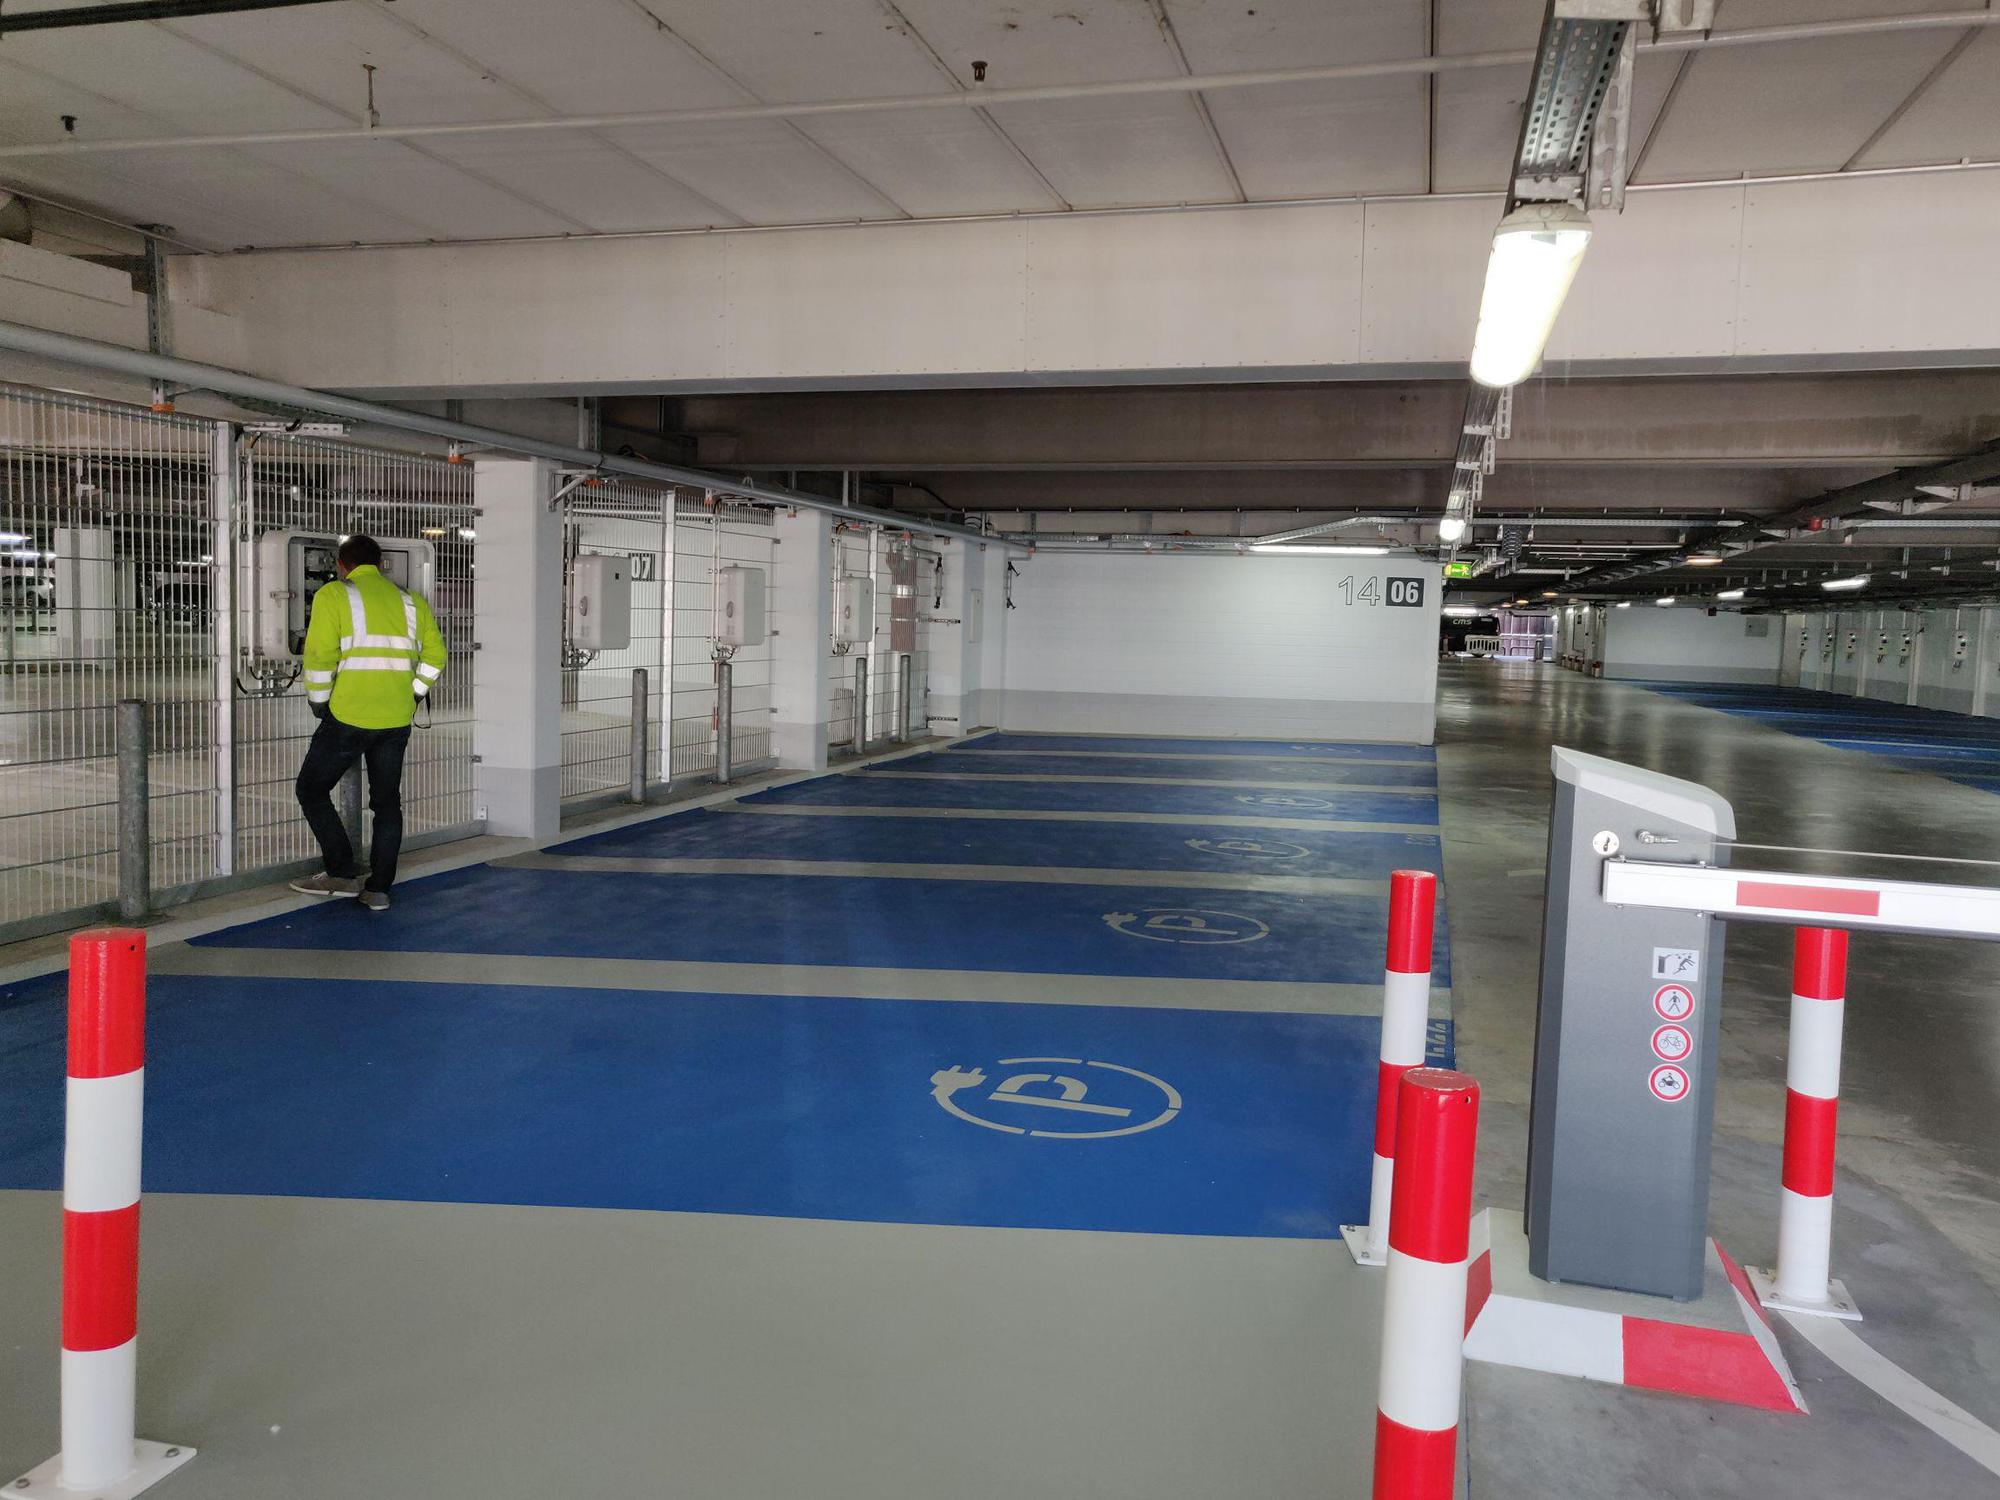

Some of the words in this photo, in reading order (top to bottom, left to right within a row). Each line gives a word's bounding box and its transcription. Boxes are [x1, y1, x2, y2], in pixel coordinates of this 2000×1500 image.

[1338, 575, 1381, 606] 14
[1390, 580, 1419, 604] 06
[988, 1073, 1132, 1117] P
